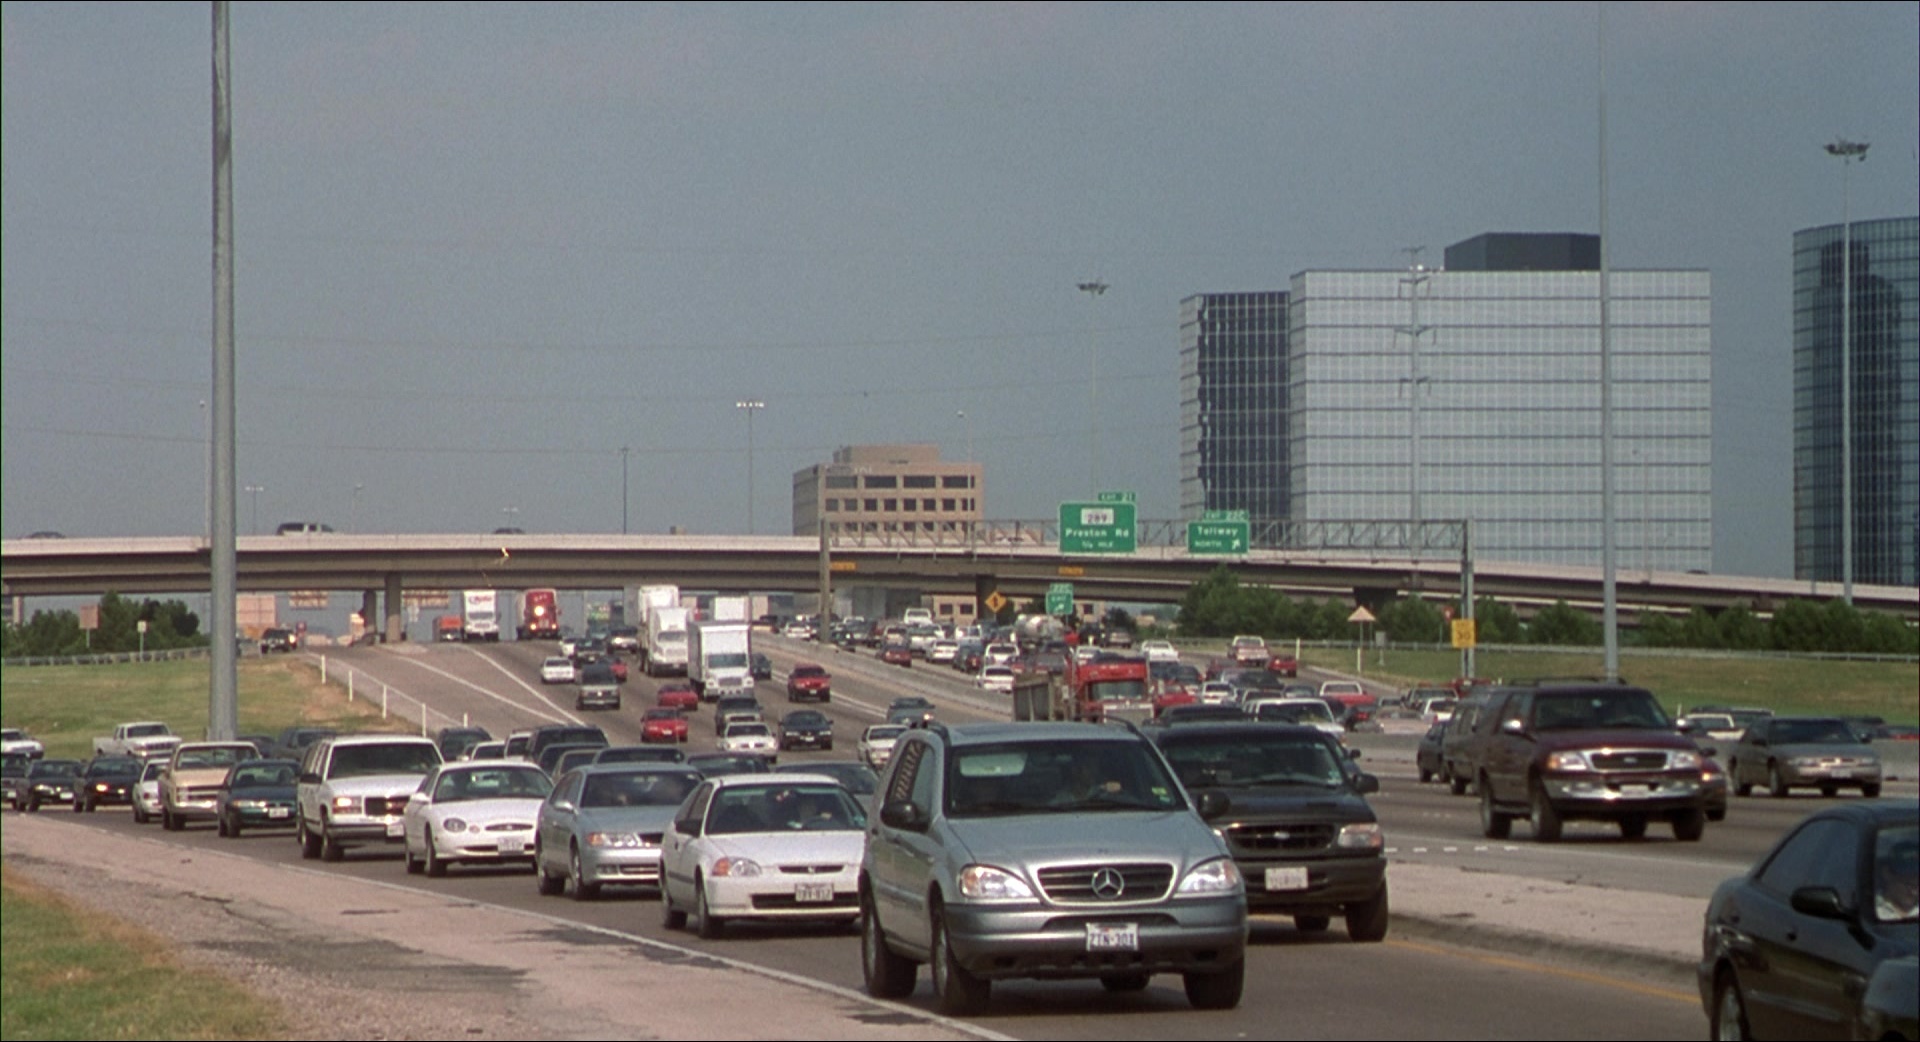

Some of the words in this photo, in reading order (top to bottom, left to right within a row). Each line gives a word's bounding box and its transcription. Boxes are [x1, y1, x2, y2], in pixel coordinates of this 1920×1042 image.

[1087, 513, 1108, 522] 289
[1065, 527, 1108, 537] Preston
[1115, 527, 1130, 537] Rd
[1197, 526, 1239, 537] Tollway
